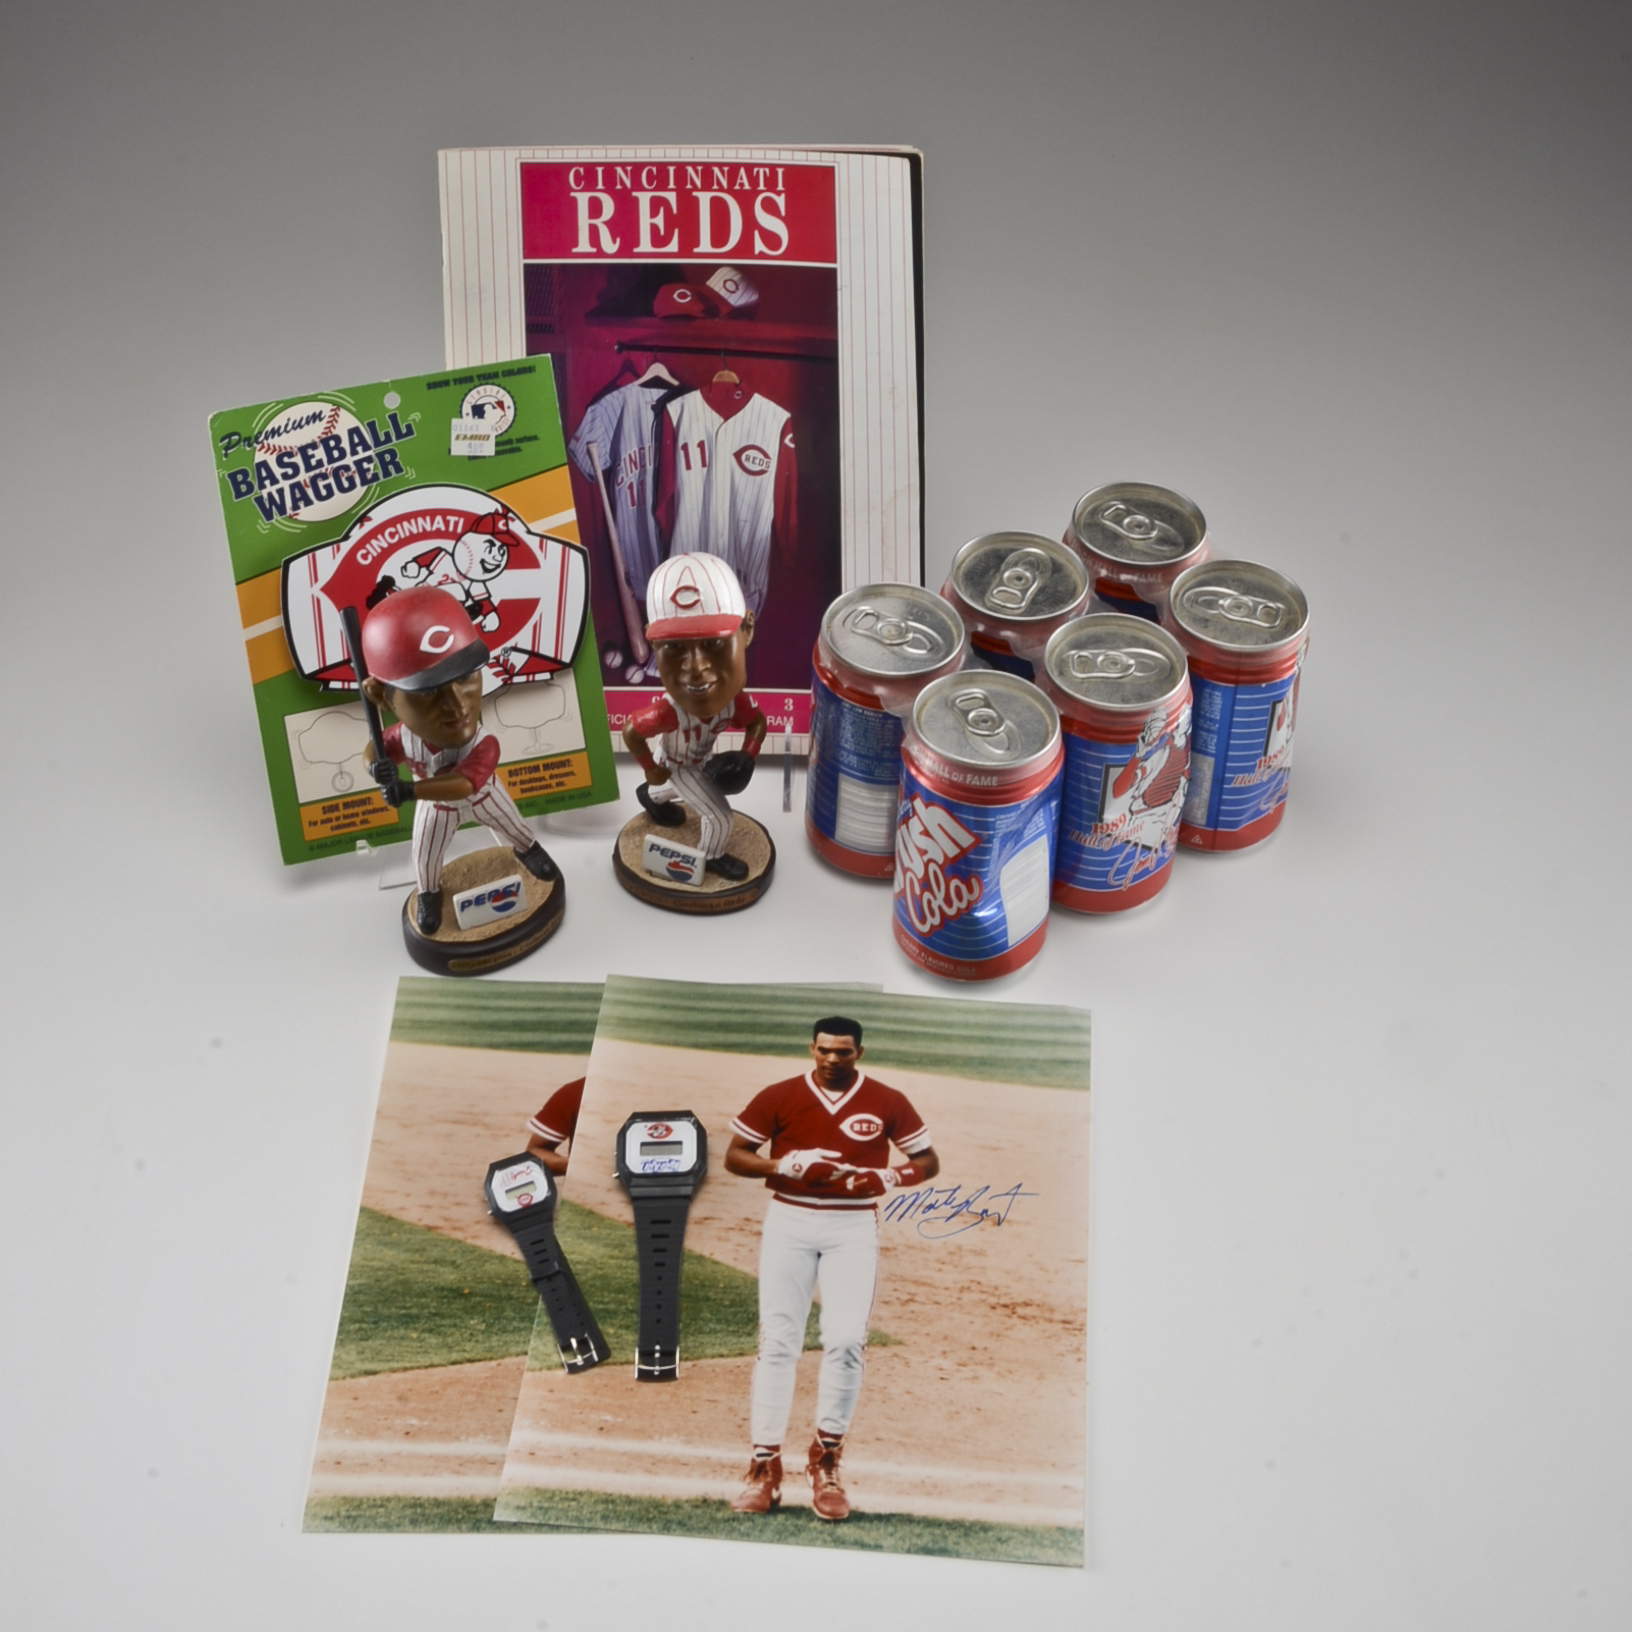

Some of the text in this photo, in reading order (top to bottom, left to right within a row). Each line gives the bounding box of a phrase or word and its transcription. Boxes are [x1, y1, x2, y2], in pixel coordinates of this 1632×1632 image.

[567, 165, 786, 192] CINCINNATI
[569, 190, 791, 256] REDS
[476, 371, 500, 381] TEAM
[501, 365, 536, 378] COLORS!
[218, 409, 326, 460] Premium
[226, 411, 416, 502] BASEBALL
[680, 439, 708, 472] 11
[744, 453, 772, 470] REDS
[252, 447, 405, 524] WAGGER
[356, 515, 464, 565] CINCINNATI
[784, 698, 794, 712] 3
[508, 758, 574, 778] BOTTOM MOUNT:
[965, 773, 998, 787] FAME
[508, 780, 518, 788] For
[321, 796, 374, 815] SIDE MOUNT:
[308, 820, 319, 828] For
[320, 817, 334, 826] auto
[334, 815, 341, 823] or
[342, 812, 360, 820] home
[1091, 813, 1127, 836] 1989
[648, 842, 697, 867] PEPSI
[460, 881, 521, 913] PEPSI
[905, 861, 980, 933] Cola
